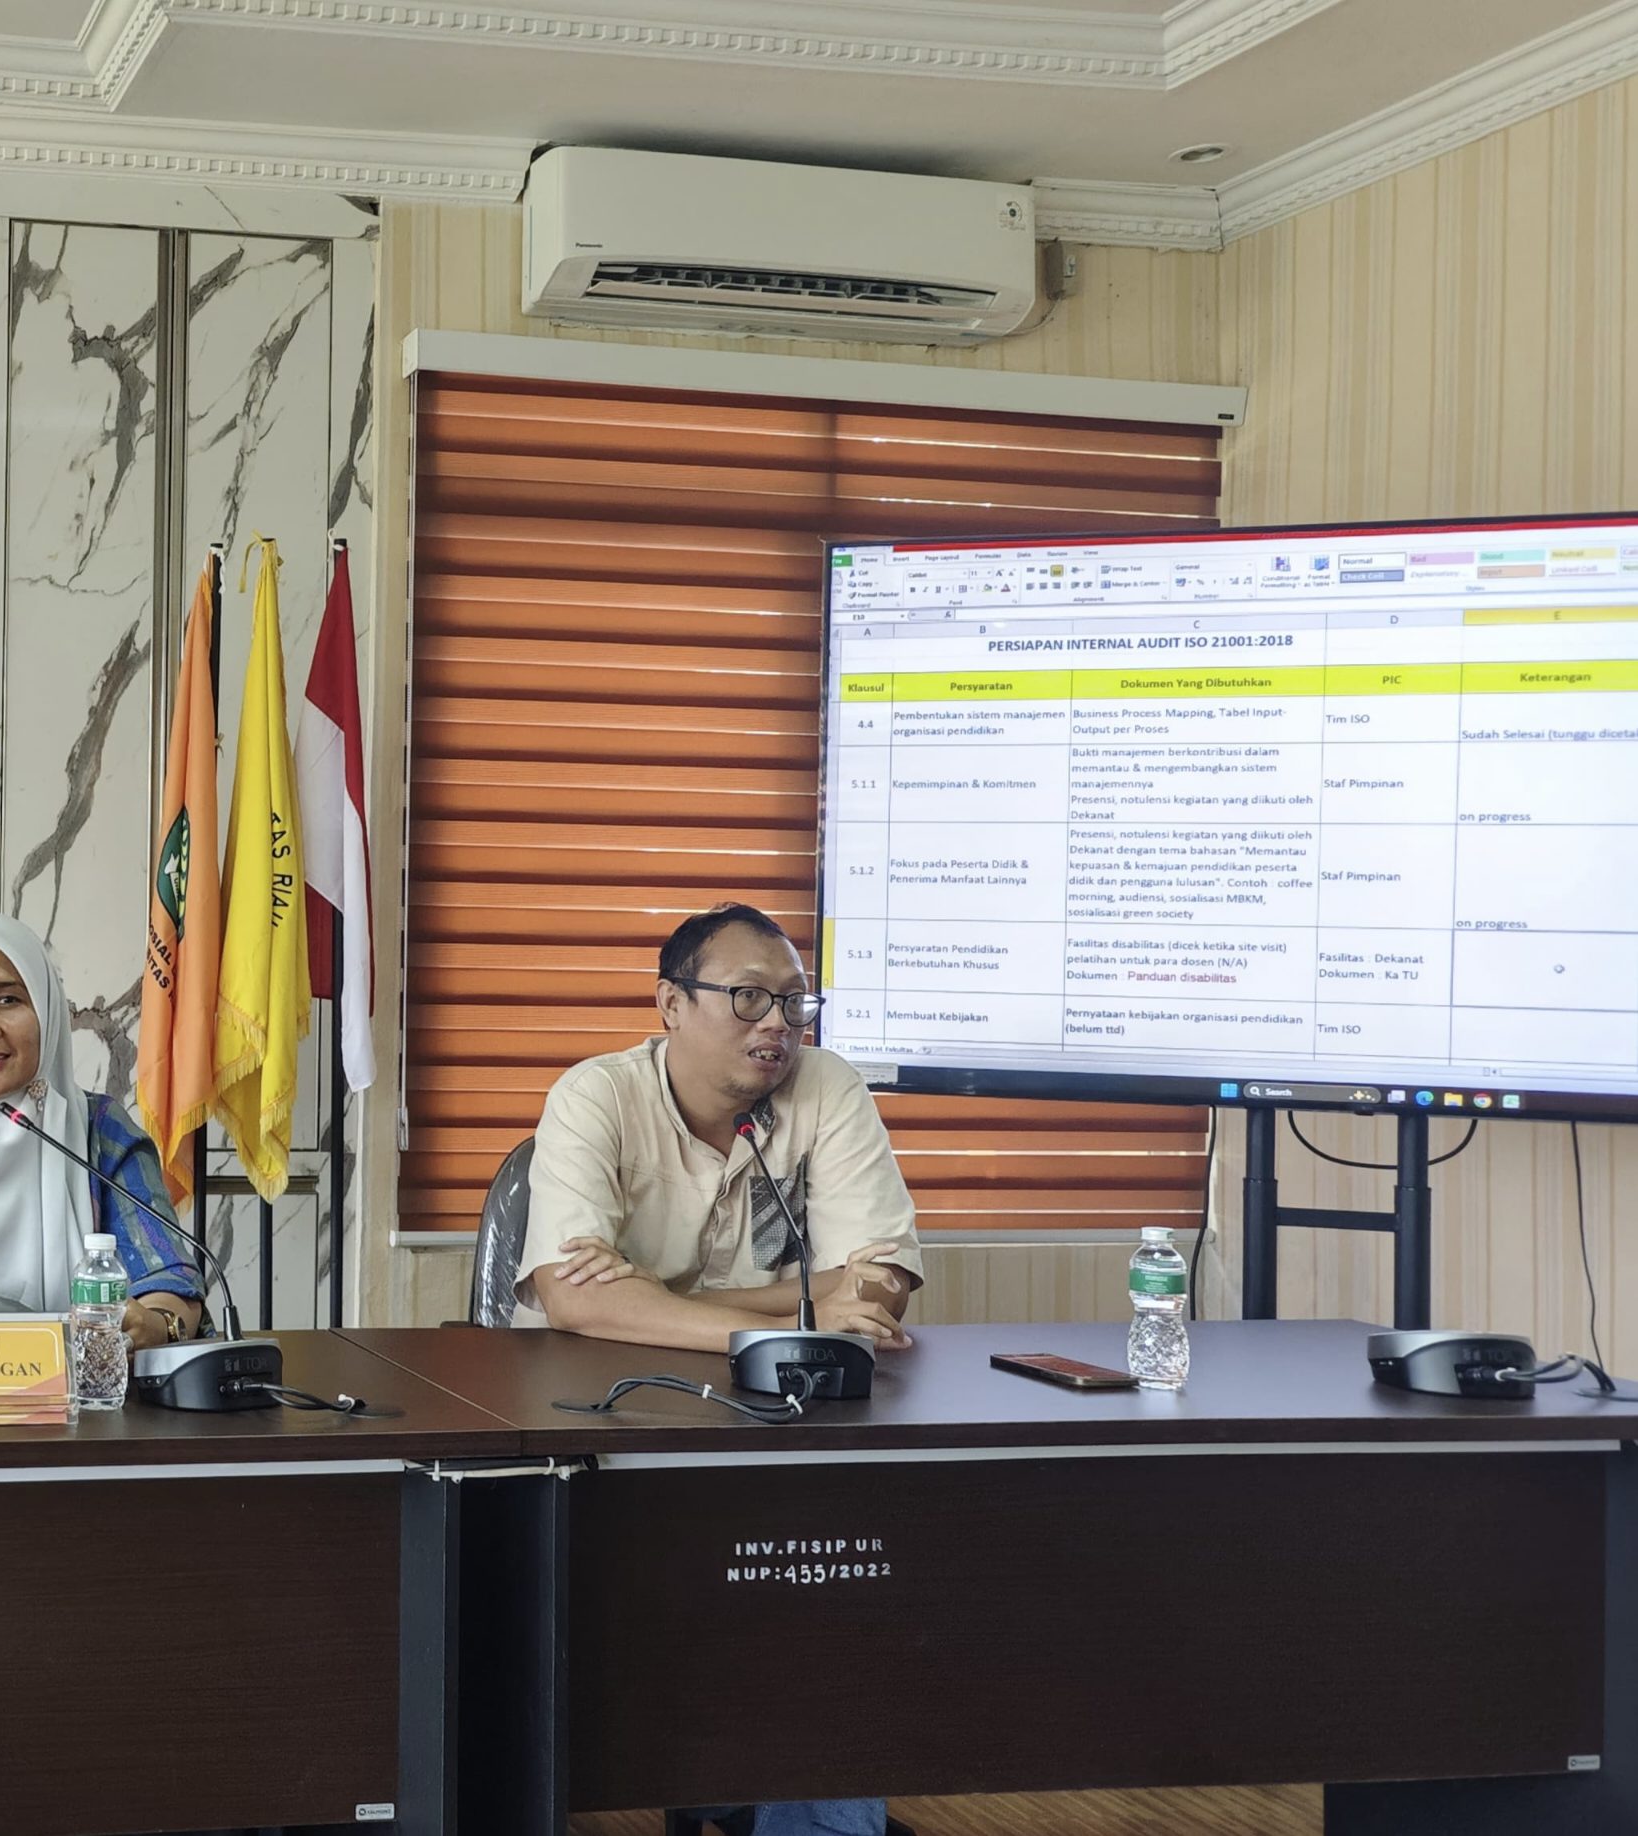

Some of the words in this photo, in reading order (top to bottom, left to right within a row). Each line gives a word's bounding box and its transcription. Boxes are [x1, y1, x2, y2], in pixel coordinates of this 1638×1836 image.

[988, 639, 1063, 652] PERSIAPAN
[1067, 638, 1133, 650] INTERNAL
[1137, 637, 1180, 648] AUDIT
[1185, 637, 1208, 648] ISO
[1211, 635, 1294, 647] 21001:2018
[1382, 675, 1402, 684] PIC
[1520, 672, 1591, 684] Keterangan
[847, 683, 884, 693] Klausul
[950, 681, 1013, 692] Persyaratan
[1121, 679, 1173, 688] Dokumen
[1176, 679, 1203, 690] Yang
[1205, 678, 1271, 687] Dibutuhkan
[894, 711, 964, 720] Pembentukan
[967, 711, 1000, 720] sistem
[1004, 710, 1065, 721] manajemen
[1073, 710, 1118, 718] Business
[1122, 709, 1161, 718] Process
[1165, 709, 1215, 719] Mapping,
[1220, 708, 1249, 717] Tabel
[858, 720, 873, 728] 4.4
[1326, 715, 1346, 724] Tim
[1351, 715, 1370, 724] ISO
[893, 727, 944, 737] organisasi
[947, 726, 1004, 737] pendidikan
[1073, 725, 1110, 735] Output
[1114, 726, 1131, 735] per
[1134, 725, 1169, 734] Proses
[1462, 730, 1499, 739] Sudah
[1503, 730, 1544, 739] Selesai
[1073, 748, 1099, 757] Bukti
[1102, 748, 1165, 758] manajemen
[1168, 747, 1241, 756] berkontribusi
[1245, 747, 1279, 756] dalam
[1072, 764, 1129, 773] memantau
[1144, 764, 1237, 774] mengembangkan
[1241, 764, 1277, 772] sistem
[852, 780, 876, 789] 5.1.1
[893, 780, 968, 790] Kepemimpinan
[984, 780, 1036, 789] Komitmen
[1071, 780, 1153, 790] manajemennya
[1324, 779, 1345, 788] Staf
[1349, 779, 1404, 789] Pimpinan
[1120, 795, 1170, 804] notulensi
[1173, 795, 1219, 806] kegiatan
[1222, 797, 1248, 806] yang
[1289, 795, 1313, 804] oleh
[1071, 811, 1115, 820] Dekanat
[1460, 813, 1474, 821] on
[1478, 813, 1531, 823] progress
[1120, 831, 1169, 840] notulensi
[1173, 831, 1217, 841] kegiatan
[1221, 832, 1247, 841] yang
[1288, 831, 1312, 840] oleh
[1070, 846, 1114, 855] Dekanat
[1117, 846, 1156, 856] dengan
[1159, 847, 1187, 855] tema
[1190, 846, 1236, 855] bahasan
[890, 859, 919, 868] Fokus
[922, 860, 947, 870] pada
[951, 860, 989, 869] Peserta
[992, 860, 1017, 869] Didik
[1070, 862, 1119, 871] kepuasan
[1135, 862, 1187, 872] kemajuan
[1191, 862, 1251, 872] pendidikan
[1255, 864, 1297, 872] peserta
[850, 867, 874, 875] 5.1.2
[890, 875, 937, 884] Penerima
[941, 875, 984, 884] Manfaat
[987, 875, 1027, 885] Lainnya
[1322, 871, 1343, 881] Staf
[1347, 872, 1401, 882] Pimpinan
[1069, 877, 1094, 886] didik
[1097, 877, 1116, 886] dan
[1120, 878, 1172, 888] pengguna
[1227, 879, 1267, 888] Contoh
[1277, 879, 1312, 888] coffee
[1170, 894, 1223, 903] sosialisasi
[1068, 908, 1120, 918] sosialisasi
[1123, 910, 1153, 919] green
[1156, 910, 1194, 920] society
[1456, 920, 1471, 928] on
[1475, 920, 1528, 930] progress
[888, 944, 948, 953] Persyaratan
[952, 944, 1008, 954] Pendidikan
[1067, 939, 1108, 948] Fasilitas
[1112, 940, 1165, 949] disabilitas
[1168, 941, 1199, 951] (dicek
[1203, 941, 1235, 951] ketika
[1239, 942, 1257, 951] site
[1261, 943, 1286, 953] visit)
[848, 951, 872, 959] 5.1.3
[1375, 954, 1423, 964] Dekanat
[888, 959, 959, 969] Berkebutuhan
[963, 961, 999, 970] Khusus
[1067, 955, 1116, 965] pelatihan
[1120, 956, 1150, 965] untuk
[1153, 957, 1178, 966] para
[1181, 957, 1214, 966] dosen
[1217, 957, 1247, 967] (N/A)
[1067, 971, 1117, 980] Dokumen
[1128, 971, 1176, 982] Panduan
[1180, 973, 1236, 983] disabilitas
[1385, 971, 1399, 980] Ka
[1403, 971, 1418, 980] TU
[846, 1009, 870, 1018] 5.2.1
[887, 1011, 936, 1021] Membuat
[940, 1012, 988, 1023] Kebijakan
[1066, 1009, 1125, 1019] Pernyataan
[1129, 1010, 1179, 1021] kebijakan
[1183, 1012, 1237, 1023] organisasi
[1241, 1014, 1303, 1024] pendidikan
[1066, 1024, 1102, 1034] (belum
[1106, 1025, 1124, 1035] ttd)
[1317, 1024, 1338, 1033] Tim
[1342, 1025, 1361, 1034] ISO
[1266, 1087, 1292, 1097] Search
